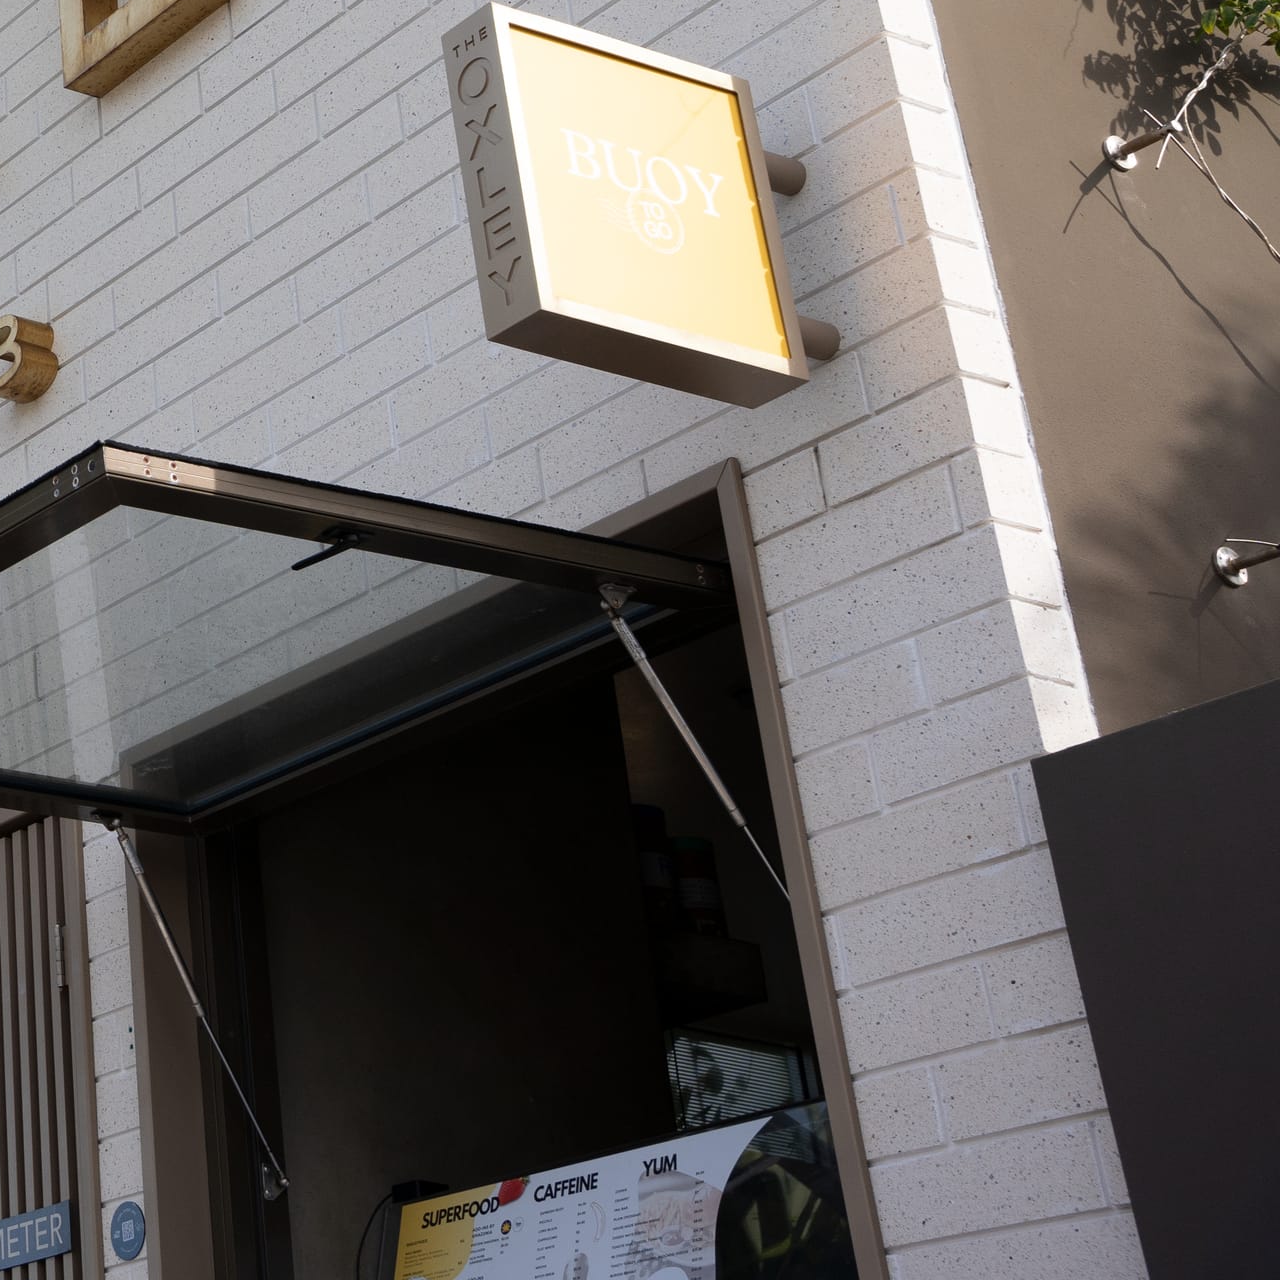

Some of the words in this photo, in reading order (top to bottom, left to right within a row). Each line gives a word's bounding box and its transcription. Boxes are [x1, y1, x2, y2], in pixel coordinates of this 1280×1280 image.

[452, 26, 488, 59] THE
[457, 56, 522, 307] OXLEY
[559, 127, 725, 218] BUOY
[639, 201, 665, 221] TO
[643, 220, 673, 240] GO
[643, 1154, 677, 1177] YUM
[534, 1172, 599, 1203] CAFFEINE
[421, 1196, 500, 1230] SUPERFOOD
